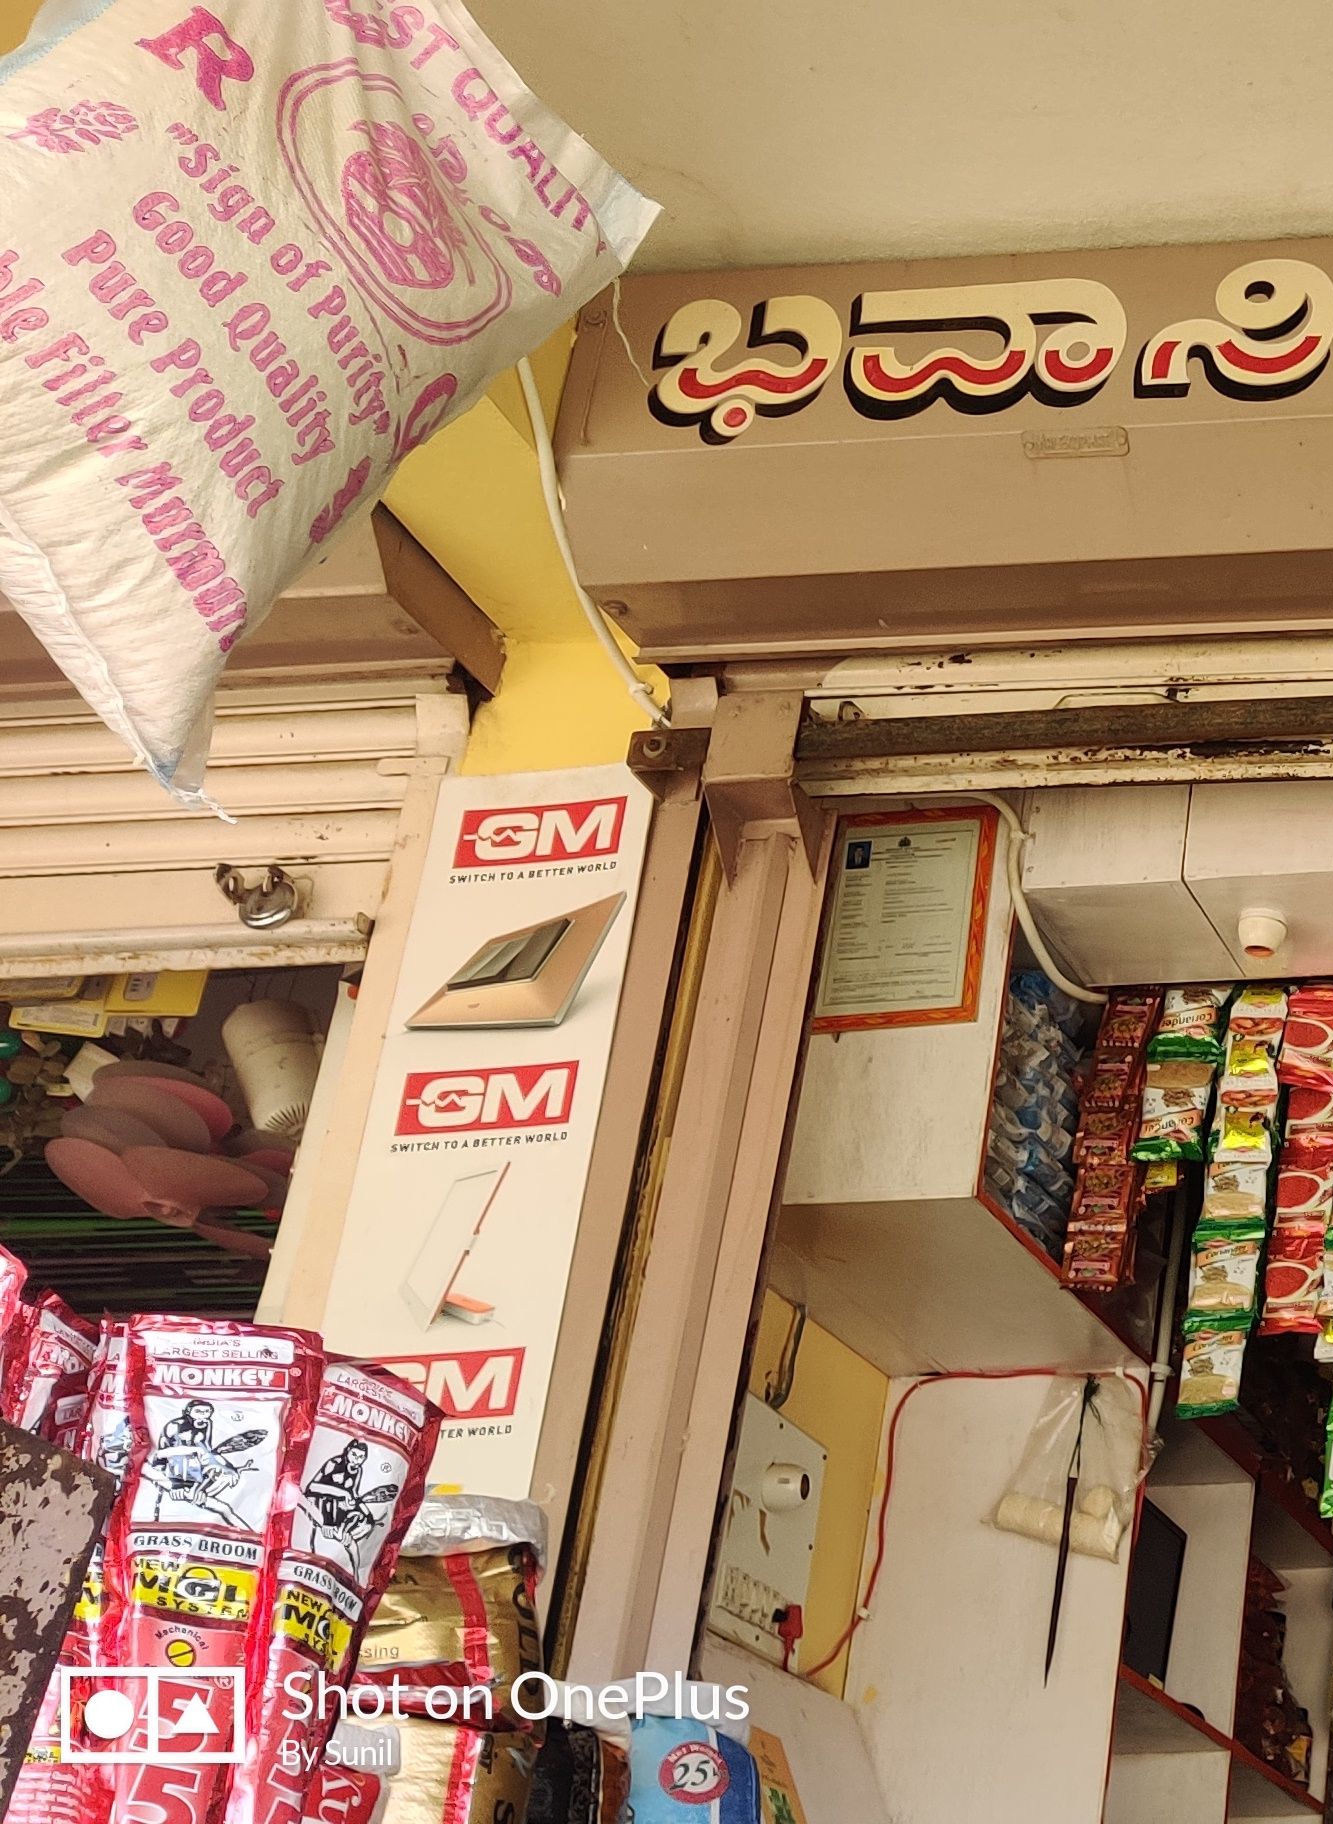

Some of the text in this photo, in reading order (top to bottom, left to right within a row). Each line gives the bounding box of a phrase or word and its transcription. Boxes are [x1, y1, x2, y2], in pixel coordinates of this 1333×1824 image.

[451, 67, 607, 257] QUALIT
[270, 243, 333, 292] of
[132, 191, 335, 466] Good Quality
[61, 229, 285, 519] Pure Product
[25, 331, 148, 458] Filter
[463, 803, 619, 861] GM
[449, 861, 617, 884] SWITCH TO A BETTER WORLD
[405, 1067, 570, 1127] GM
[390, 1131, 568, 1153] SWITCH TO A BETTER WORLD
[152, 1346, 279, 1361] LARGEST SELLING
[155, 1365, 275, 1387] MONKEY
[467, 1424, 512, 1438] WORLD
[133, 1535, 258, 1561] GRASS BROOM
[293, 1565, 334, 1595] GRASS
[286, 1589, 324, 1613] NEW
[154, 1625, 210, 1651] Mechanical
[358, 1643, 400, 1660] ssing
[670, 1760, 711, 1791] 25
